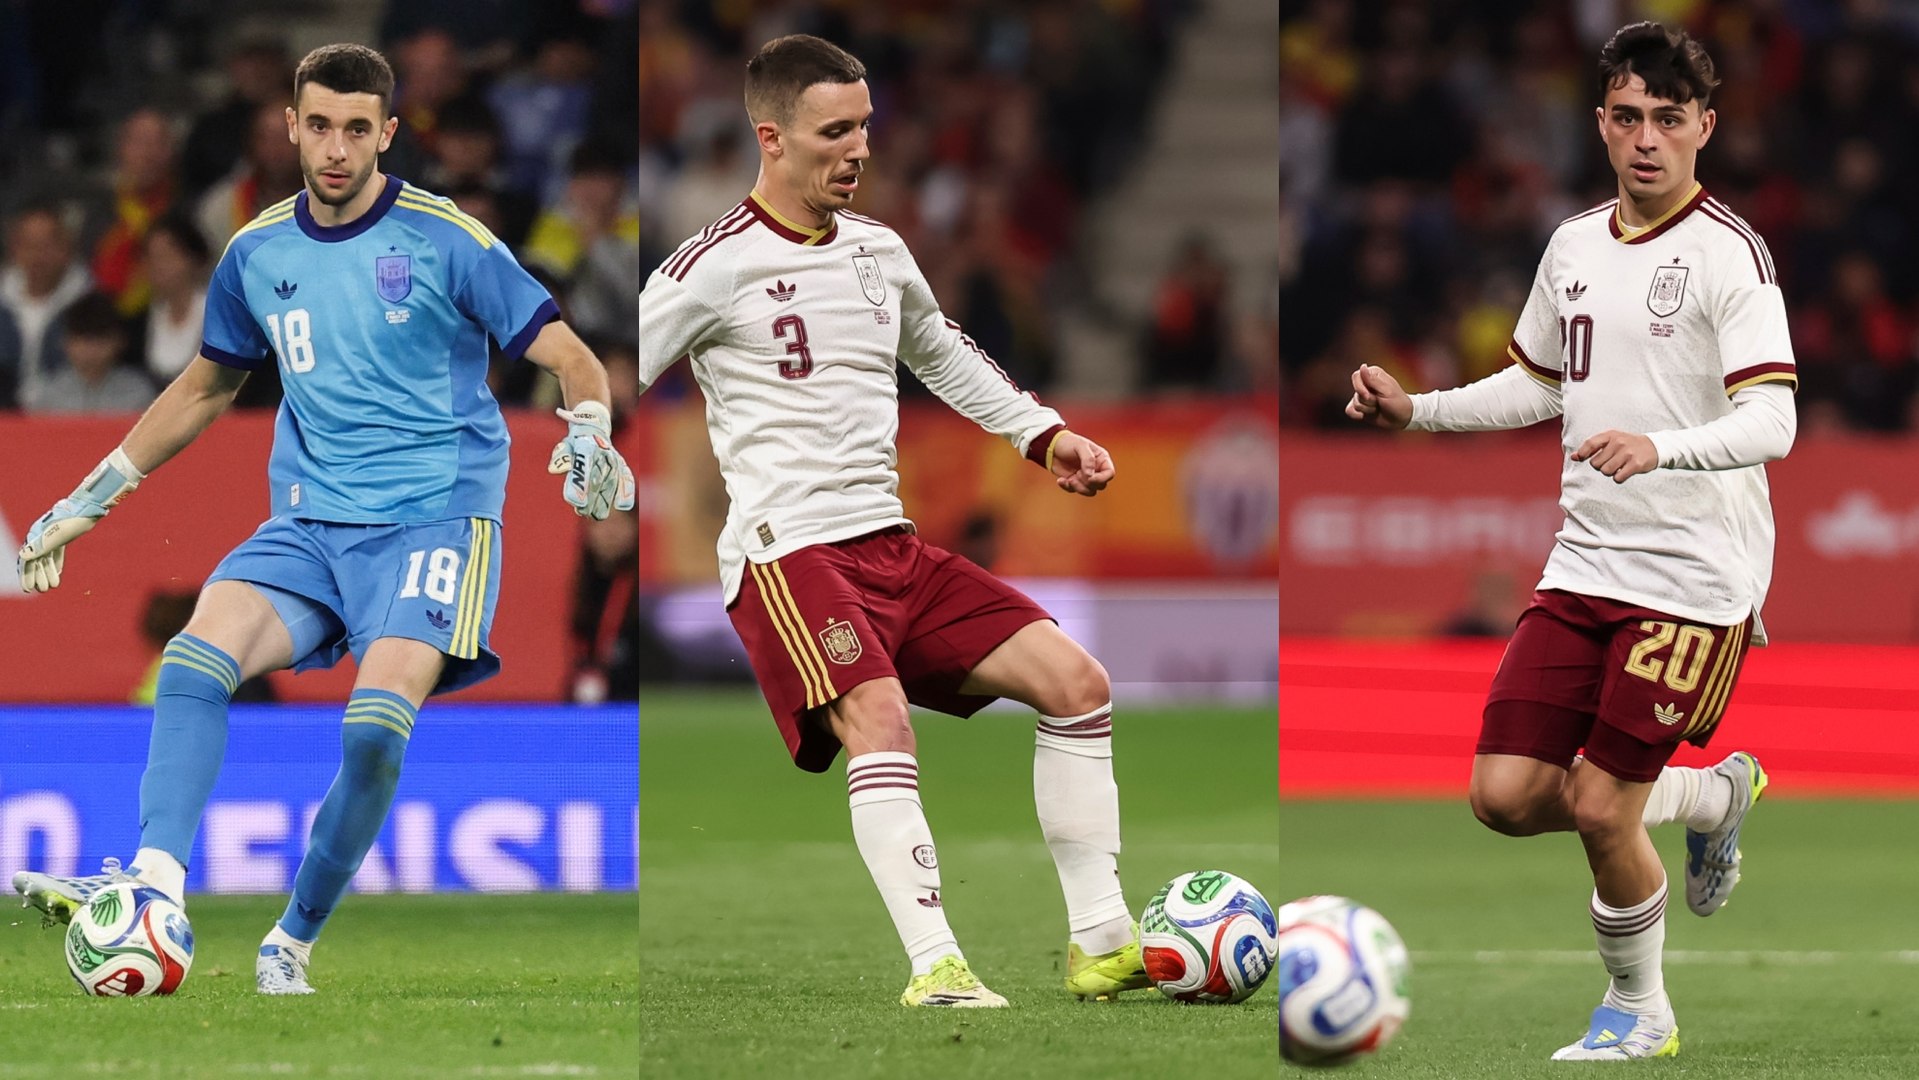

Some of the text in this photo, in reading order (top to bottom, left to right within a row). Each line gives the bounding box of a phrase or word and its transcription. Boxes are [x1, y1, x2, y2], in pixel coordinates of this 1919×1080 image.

[266, 308, 315, 374] 18
[772, 313, 814, 380] 3
[400, 547, 460, 605] 18
[1624, 621, 1715, 693] 20
